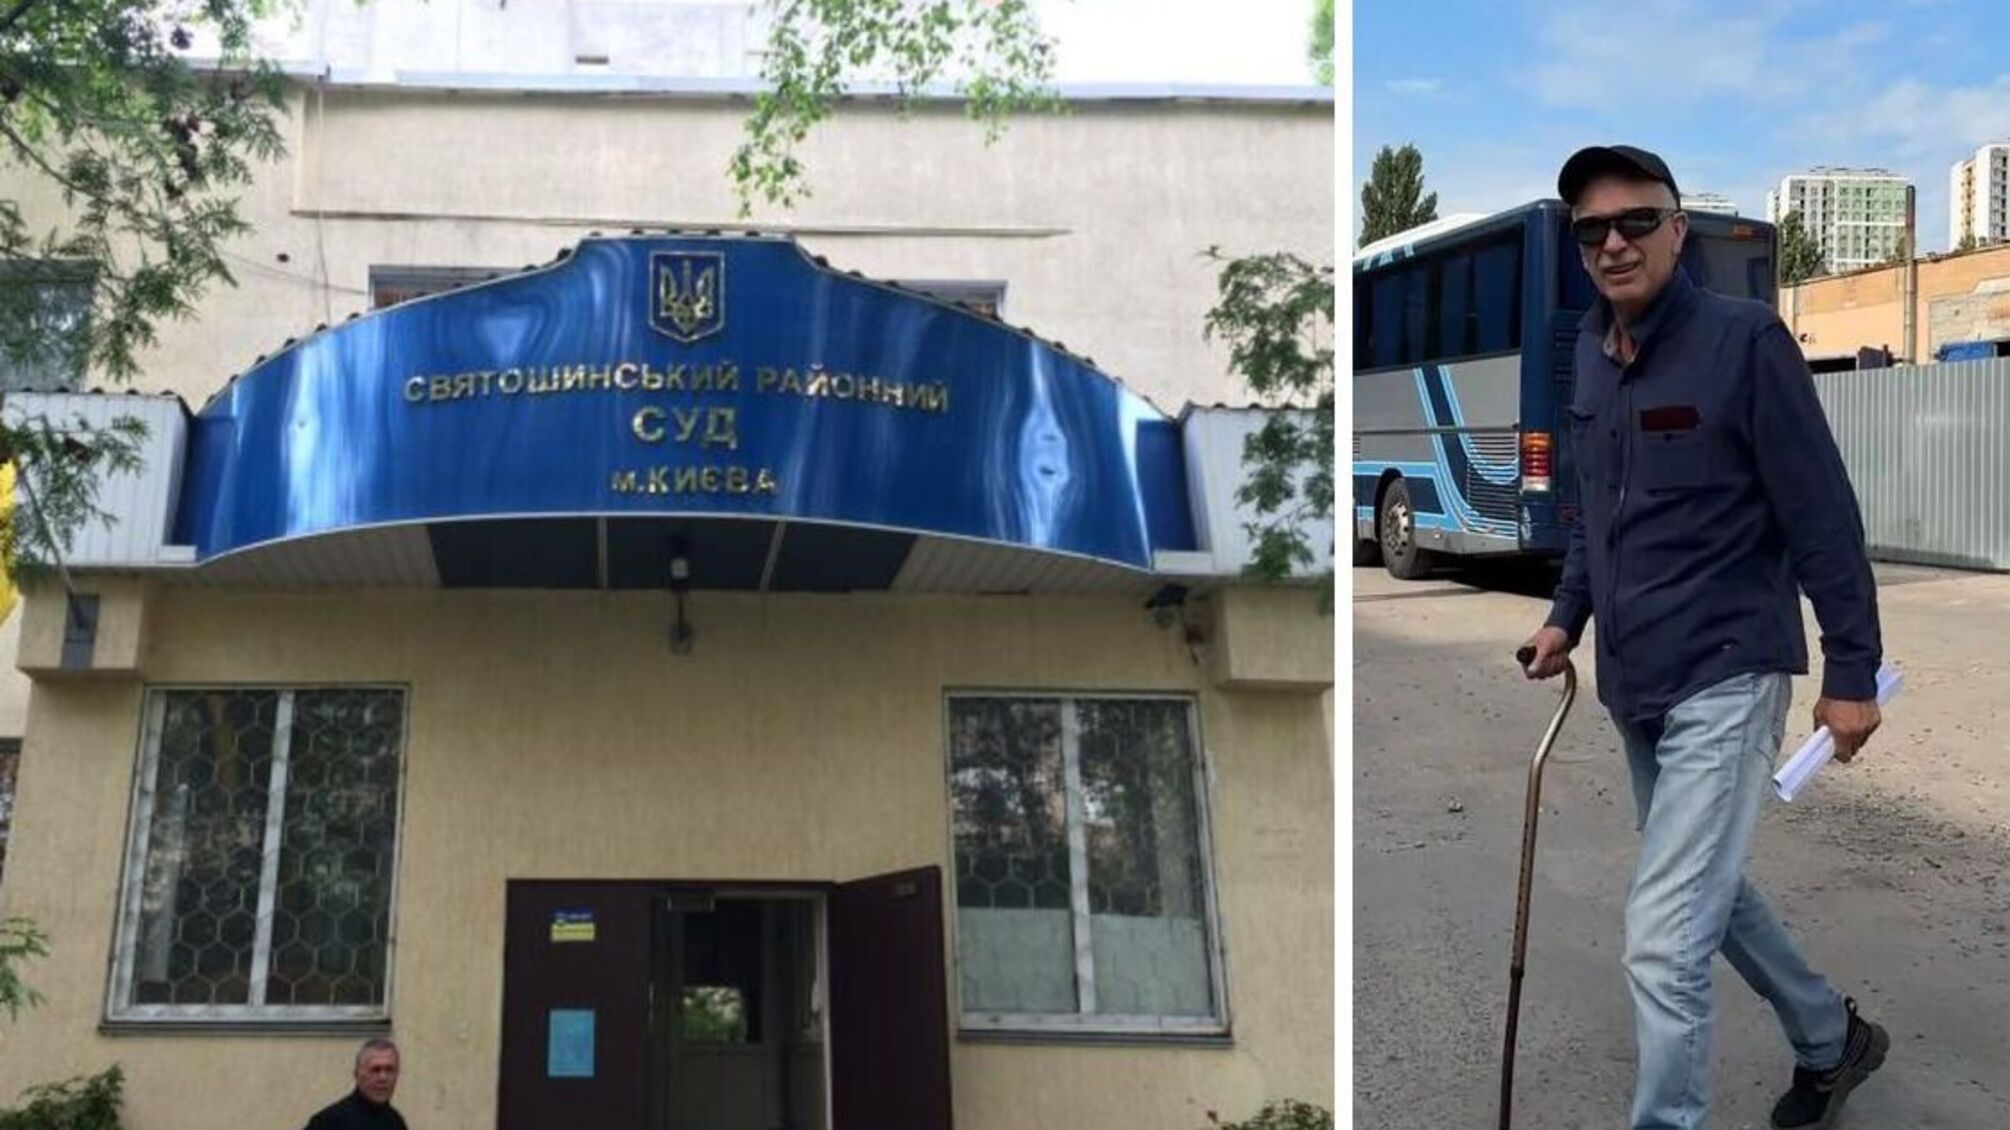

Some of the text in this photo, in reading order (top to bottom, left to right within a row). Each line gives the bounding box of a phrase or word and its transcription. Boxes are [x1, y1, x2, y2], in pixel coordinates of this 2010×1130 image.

[404, 361, 948, 413] СВЯТОШИНСЬКИЙ РАЙОННИЙ
[632, 405, 738, 449] СУД
[611, 466, 778, 495] м.КИЄВА
